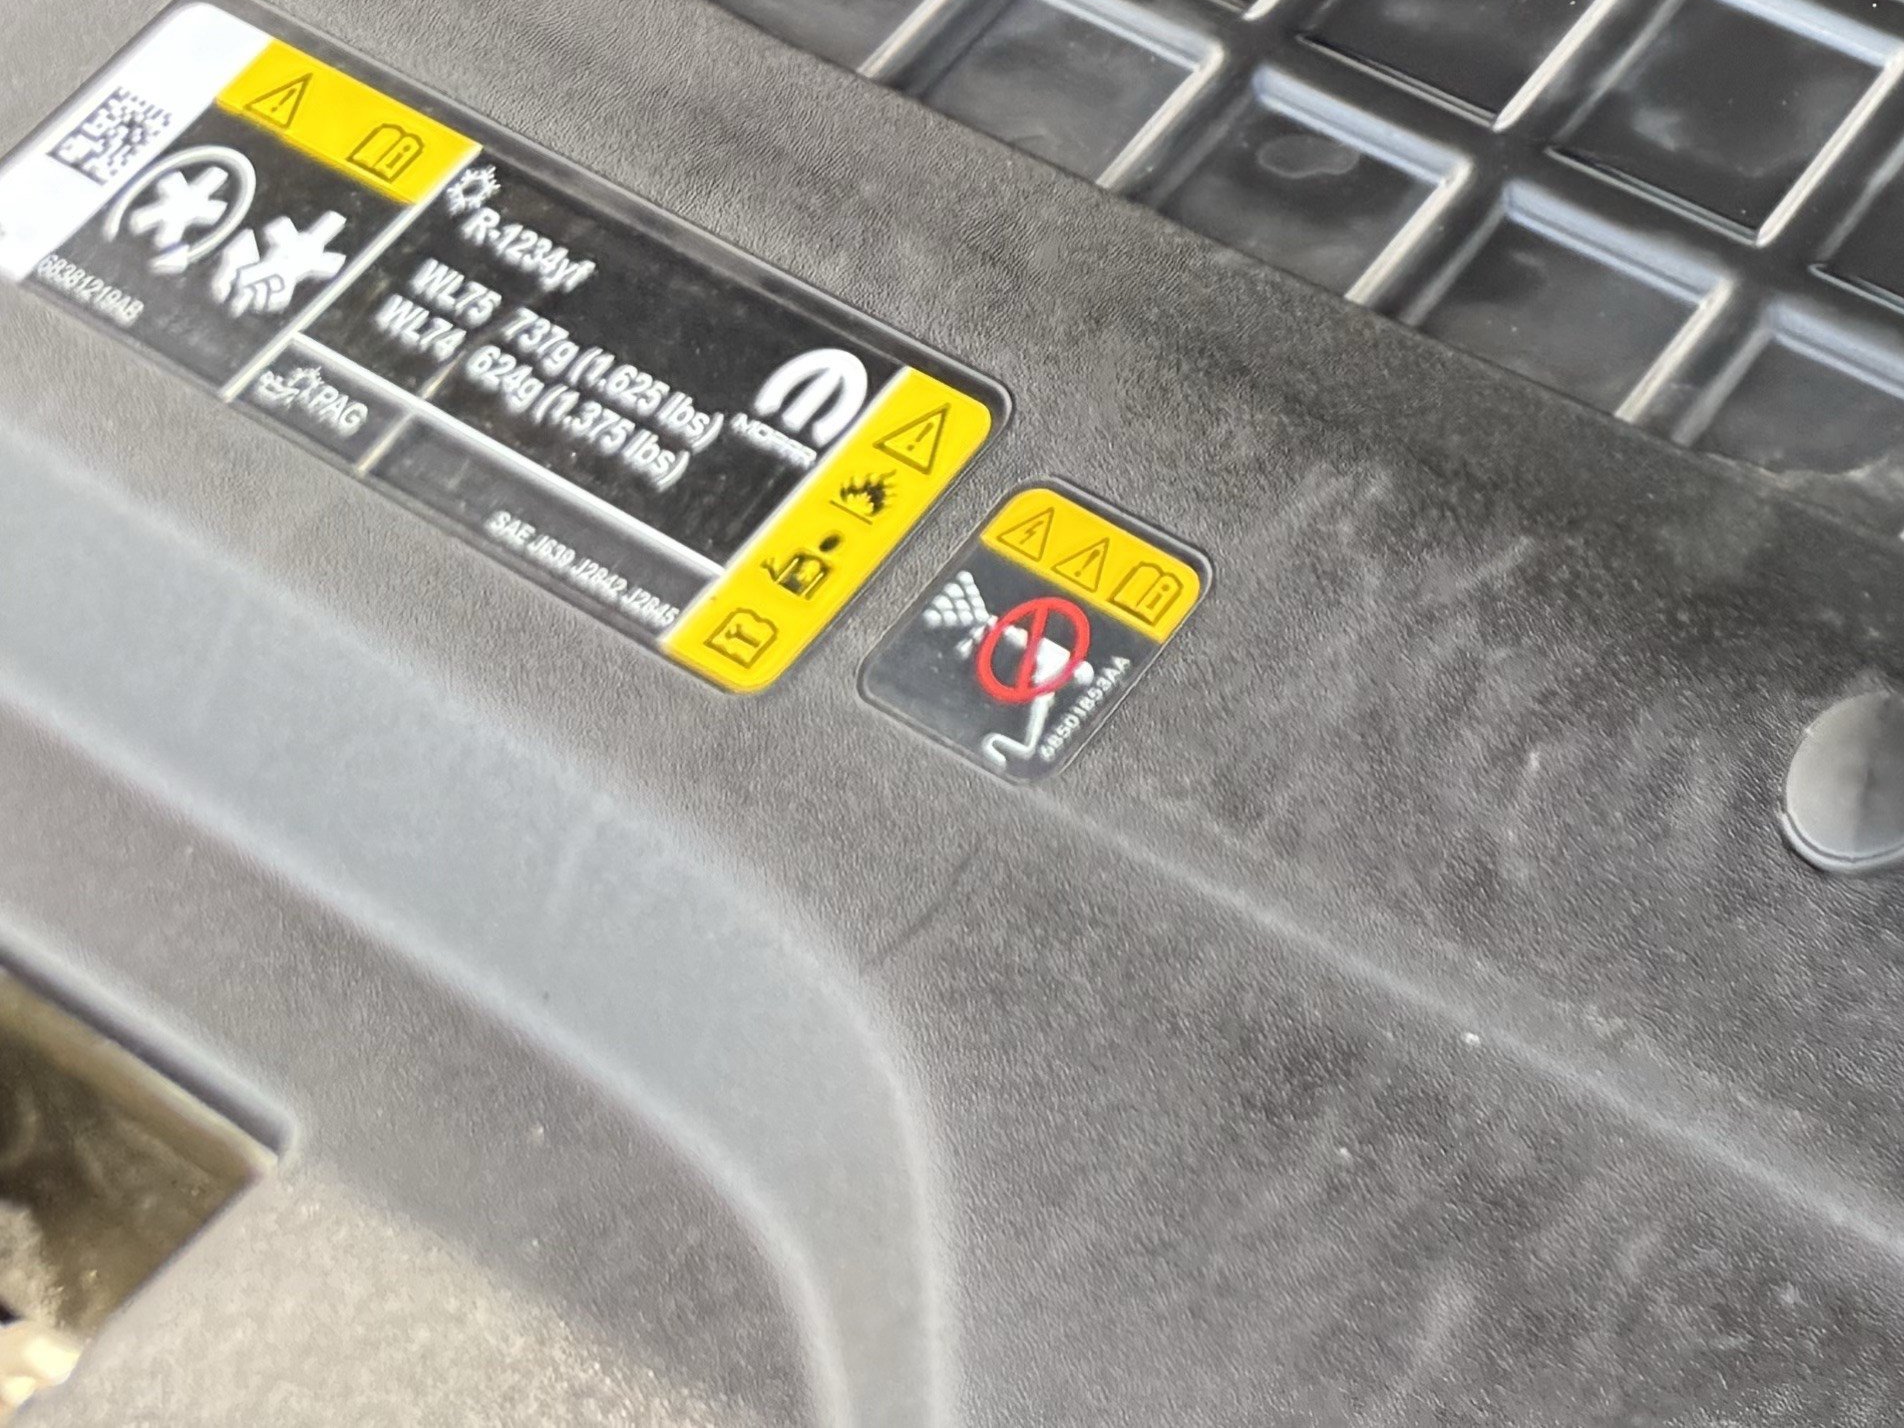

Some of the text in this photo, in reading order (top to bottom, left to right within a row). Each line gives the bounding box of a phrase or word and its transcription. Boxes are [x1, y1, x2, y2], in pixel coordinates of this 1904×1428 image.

[461, 205, 597, 293] R-1234yf
[374, 293, 691, 492] WL74 624g (1.375 lbs)
[409, 257, 725, 453] WL75 737g (1.625 lbs)
[310, 387, 369, 436] PAG
[730, 412, 818, 469] MOPAR
[484, 509, 682, 629] SAE J639 J2842 J2845
